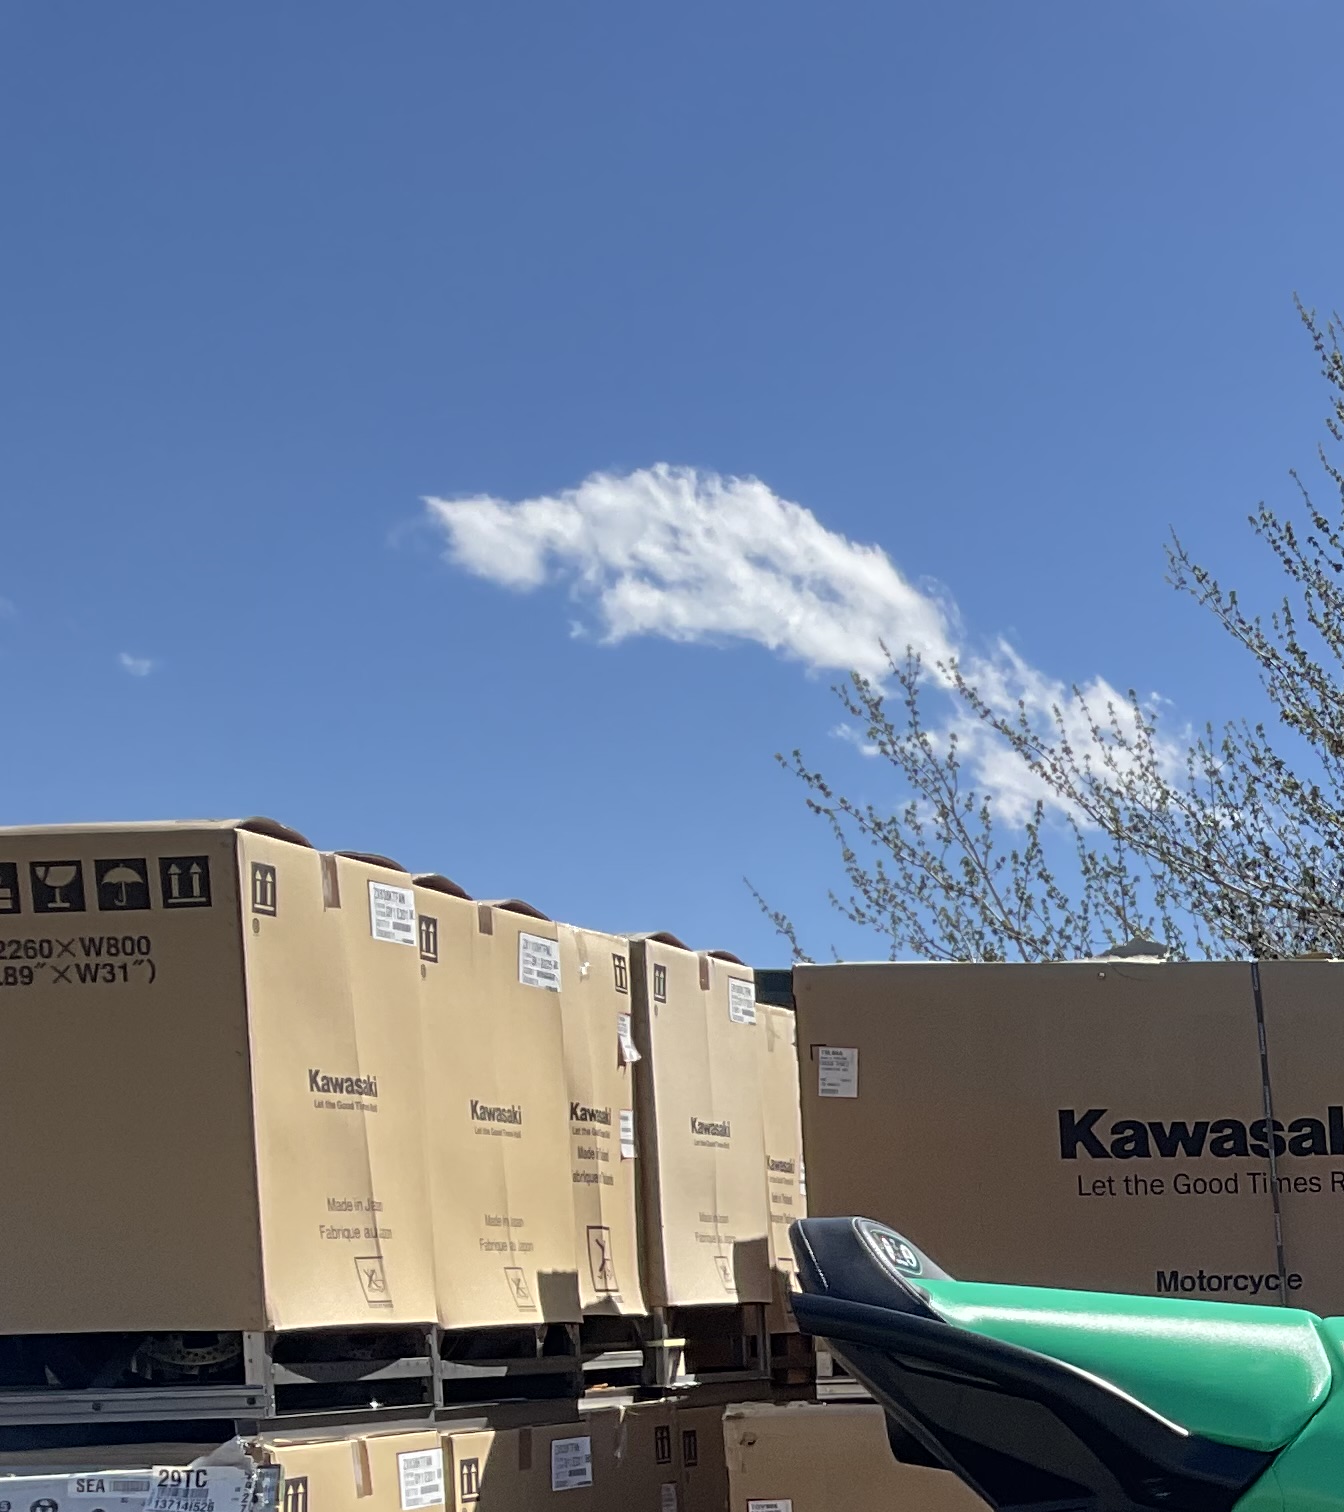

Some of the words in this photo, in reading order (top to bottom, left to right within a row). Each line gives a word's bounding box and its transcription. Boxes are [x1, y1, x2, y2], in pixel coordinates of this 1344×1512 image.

[308, 1069, 378, 1098] Kawasaki
[470, 1099, 523, 1125] Kawasaki
[690, 1116, 731, 1138] Kawasaki
[1078, 1174, 1116, 1197] Let
[1124, 1174, 1164, 1196] the
[1173, 1172, 1239, 1195] Good
[1246, 1171, 1322, 1194] Times
[1156, 1270, 1303, 1295] Motorcyce
[76, 1478, 106, 1493] SEA
[158, 1469, 208, 1488] 29TC
